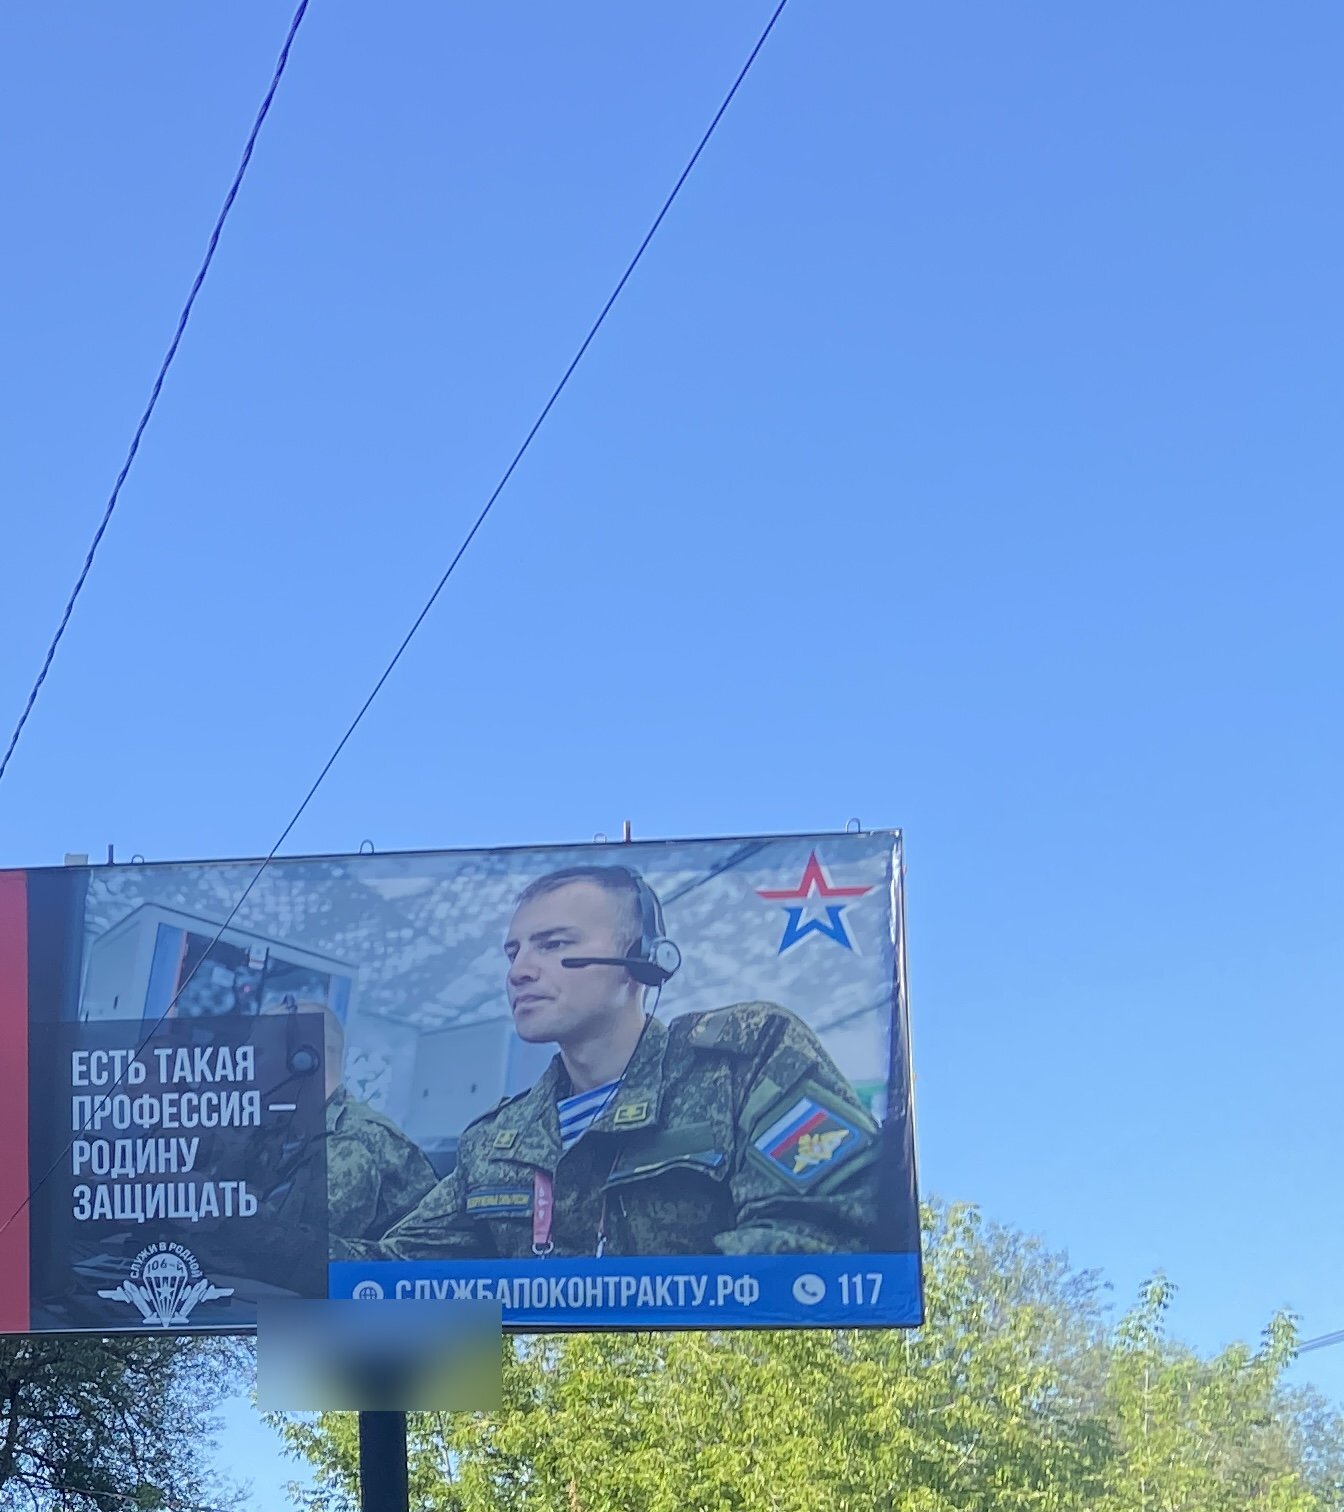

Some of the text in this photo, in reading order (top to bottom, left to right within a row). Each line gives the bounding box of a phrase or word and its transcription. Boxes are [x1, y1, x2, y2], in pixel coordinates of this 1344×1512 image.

[71, 1045, 255, 1086] ЕСТЬ ТАКАЯ
[72, 1090, 261, 1131] ПРОФЕССИЯ
[72, 1137, 200, 1179] РОДИНУ
[73, 1181, 258, 1223] ЗАЩИЩАТЬ
[130, 1241, 204, 1279] СЛУЖИ В РОДНОЙ
[838, 1273, 883, 1305] 117
